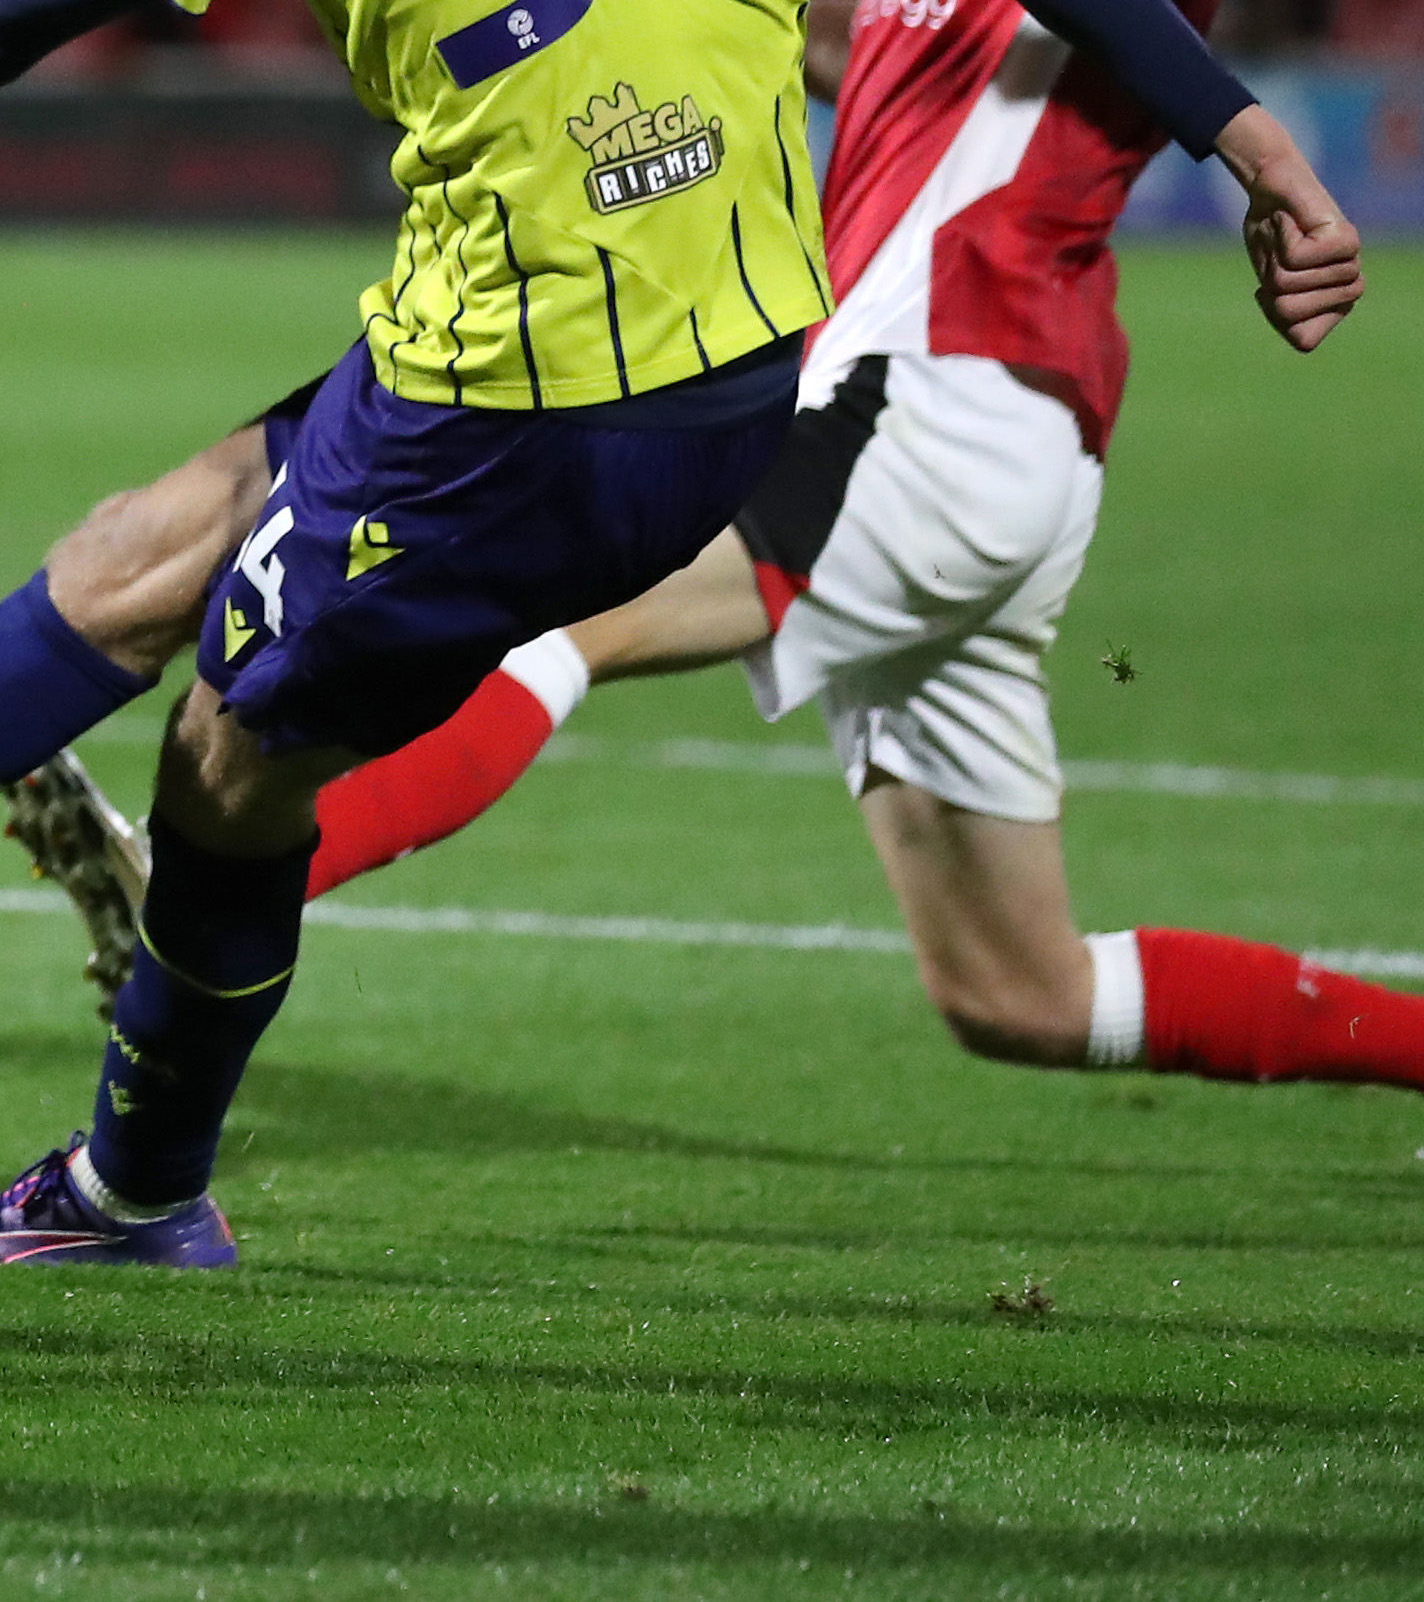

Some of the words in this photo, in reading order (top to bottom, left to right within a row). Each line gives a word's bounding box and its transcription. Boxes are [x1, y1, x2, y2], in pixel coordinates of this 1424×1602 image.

[518, 31, 541, 50] EFL
[590, 95, 705, 165] MEGA
[598, 139, 710, 205] RICHES
